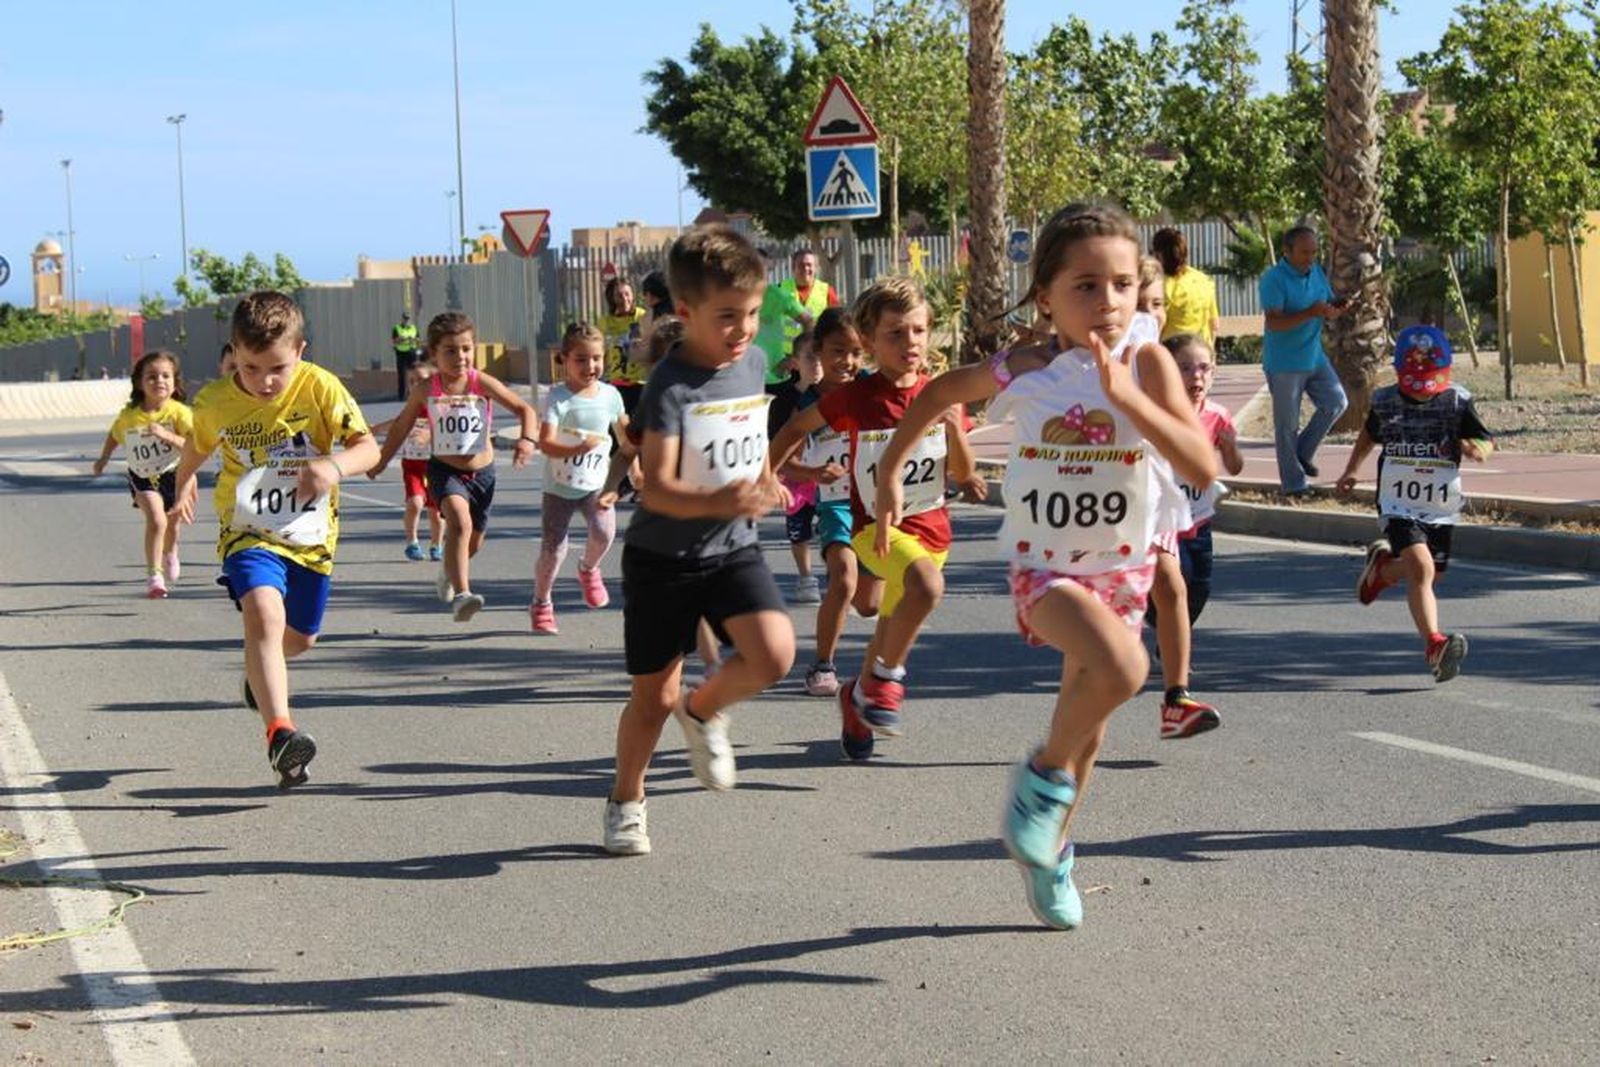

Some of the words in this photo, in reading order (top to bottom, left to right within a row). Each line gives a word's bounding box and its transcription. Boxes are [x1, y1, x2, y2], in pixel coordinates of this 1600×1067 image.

[438, 415, 481, 434] 1002
[132, 440, 172, 460] 1013
[866, 456, 937, 489] 122
[1392, 480, 1449, 503] 1011
[1021, 488, 1128, 529] 1089
